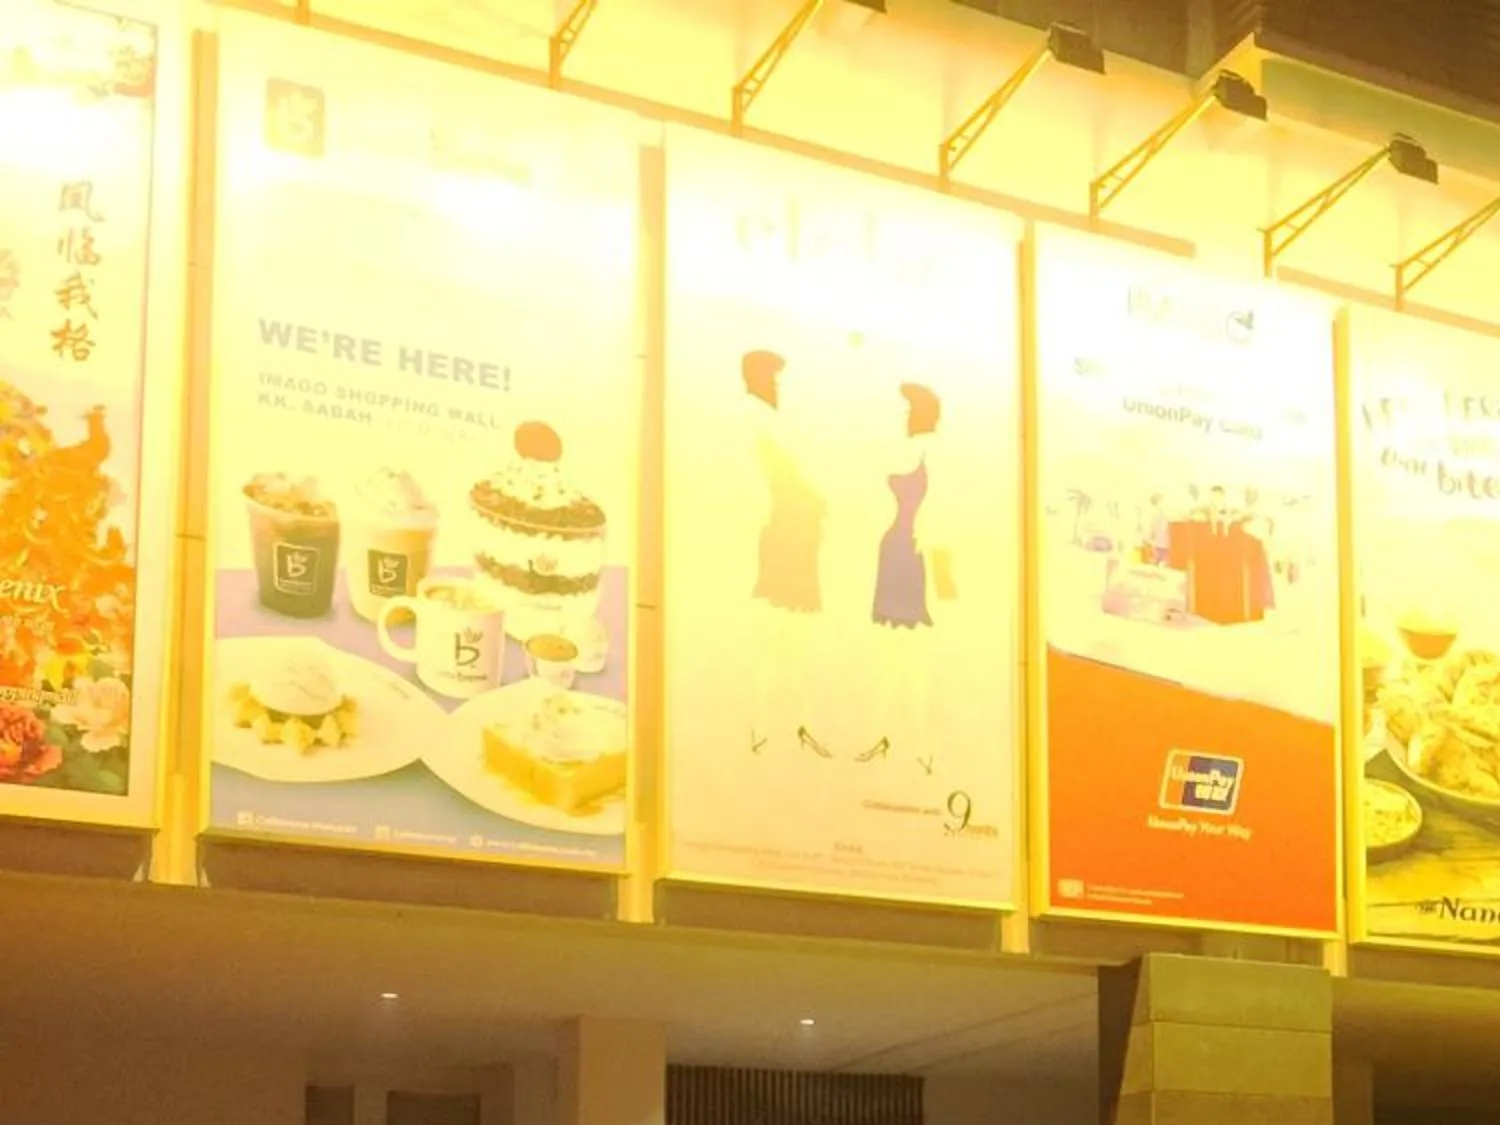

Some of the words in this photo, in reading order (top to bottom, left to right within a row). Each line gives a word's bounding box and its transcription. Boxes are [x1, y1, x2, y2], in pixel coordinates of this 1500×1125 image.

[258, 318, 383, 367] WE'RE
[399, 346, 512, 392] HERE!
[335, 385, 440, 418] SHOPPING
